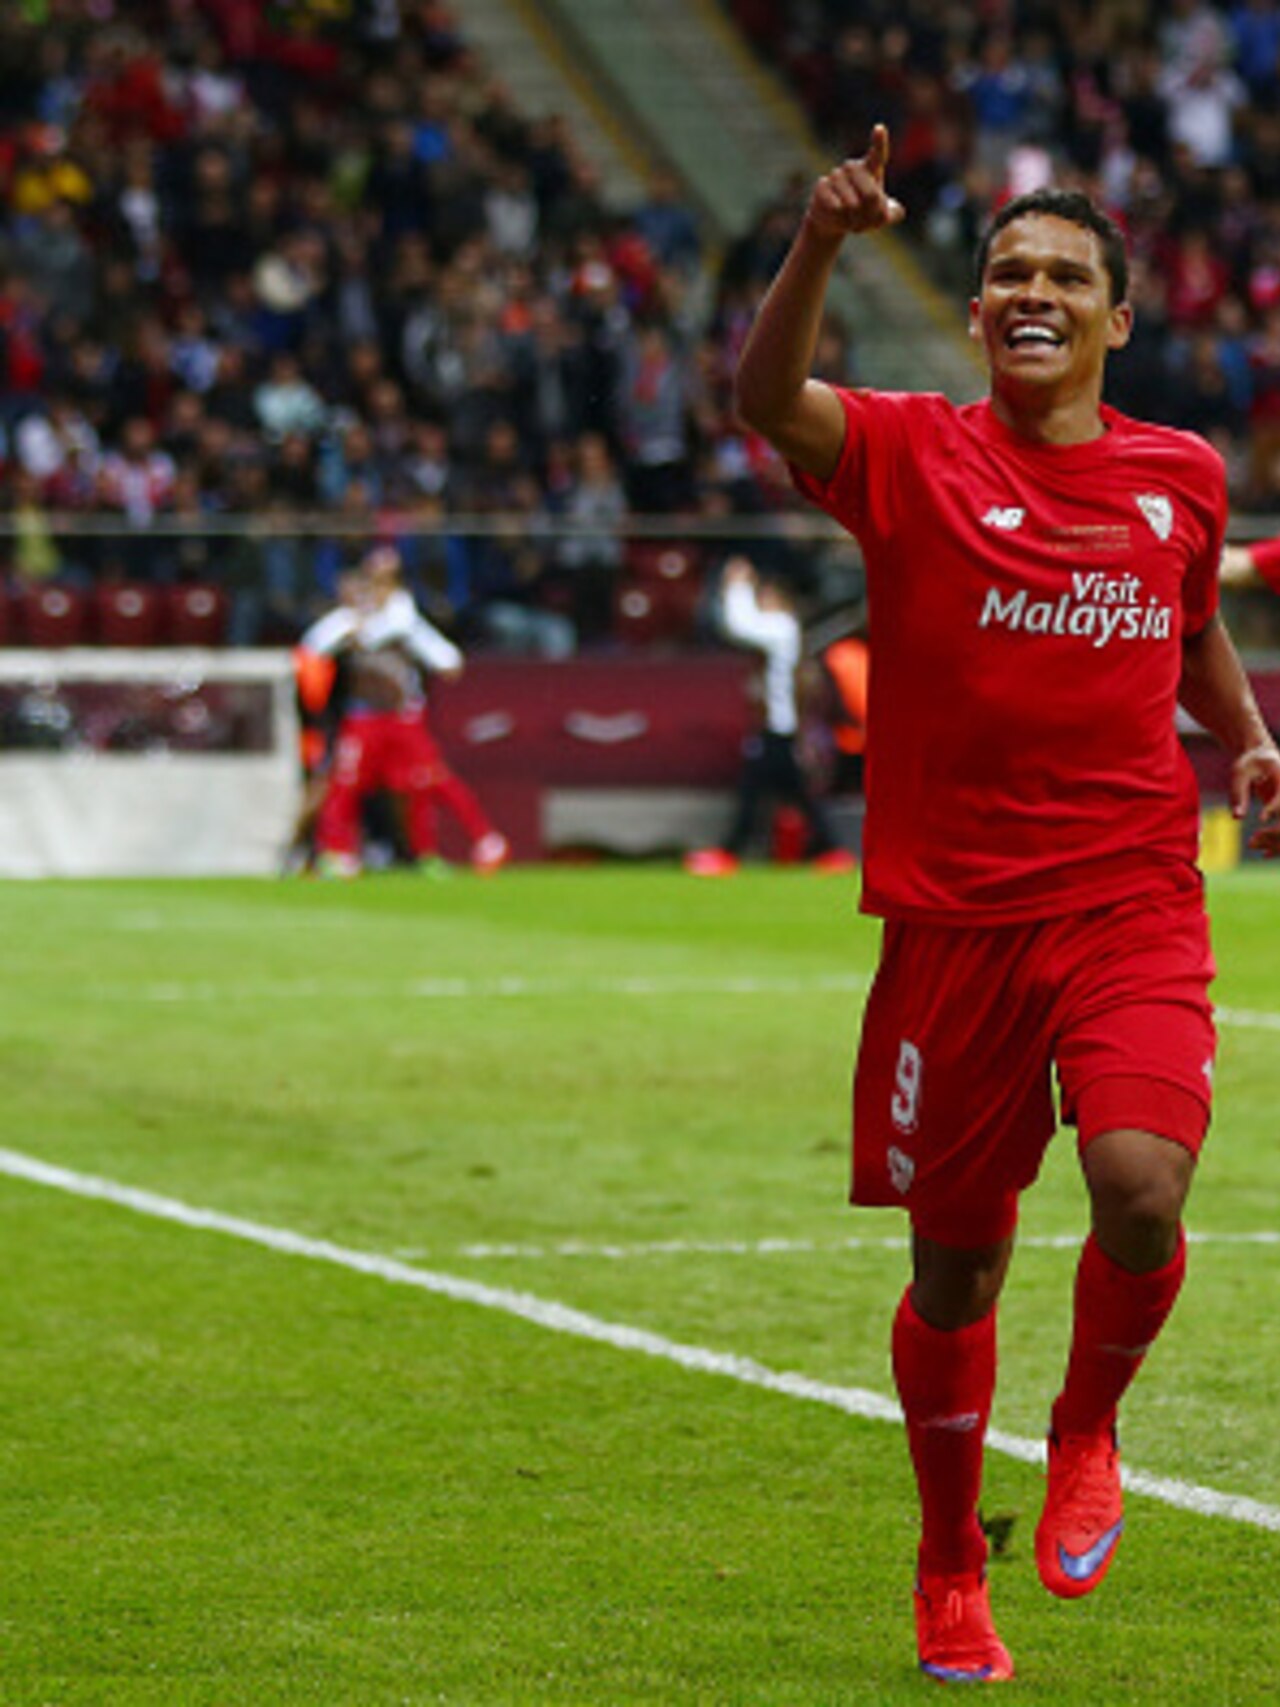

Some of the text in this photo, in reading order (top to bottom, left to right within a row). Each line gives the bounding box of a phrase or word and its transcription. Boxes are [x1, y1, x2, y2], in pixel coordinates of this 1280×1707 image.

[978, 586, 1172, 648] Malaysia
[1072, 571, 1141, 604] Visit
[892, 1039, 922, 1130] 9
